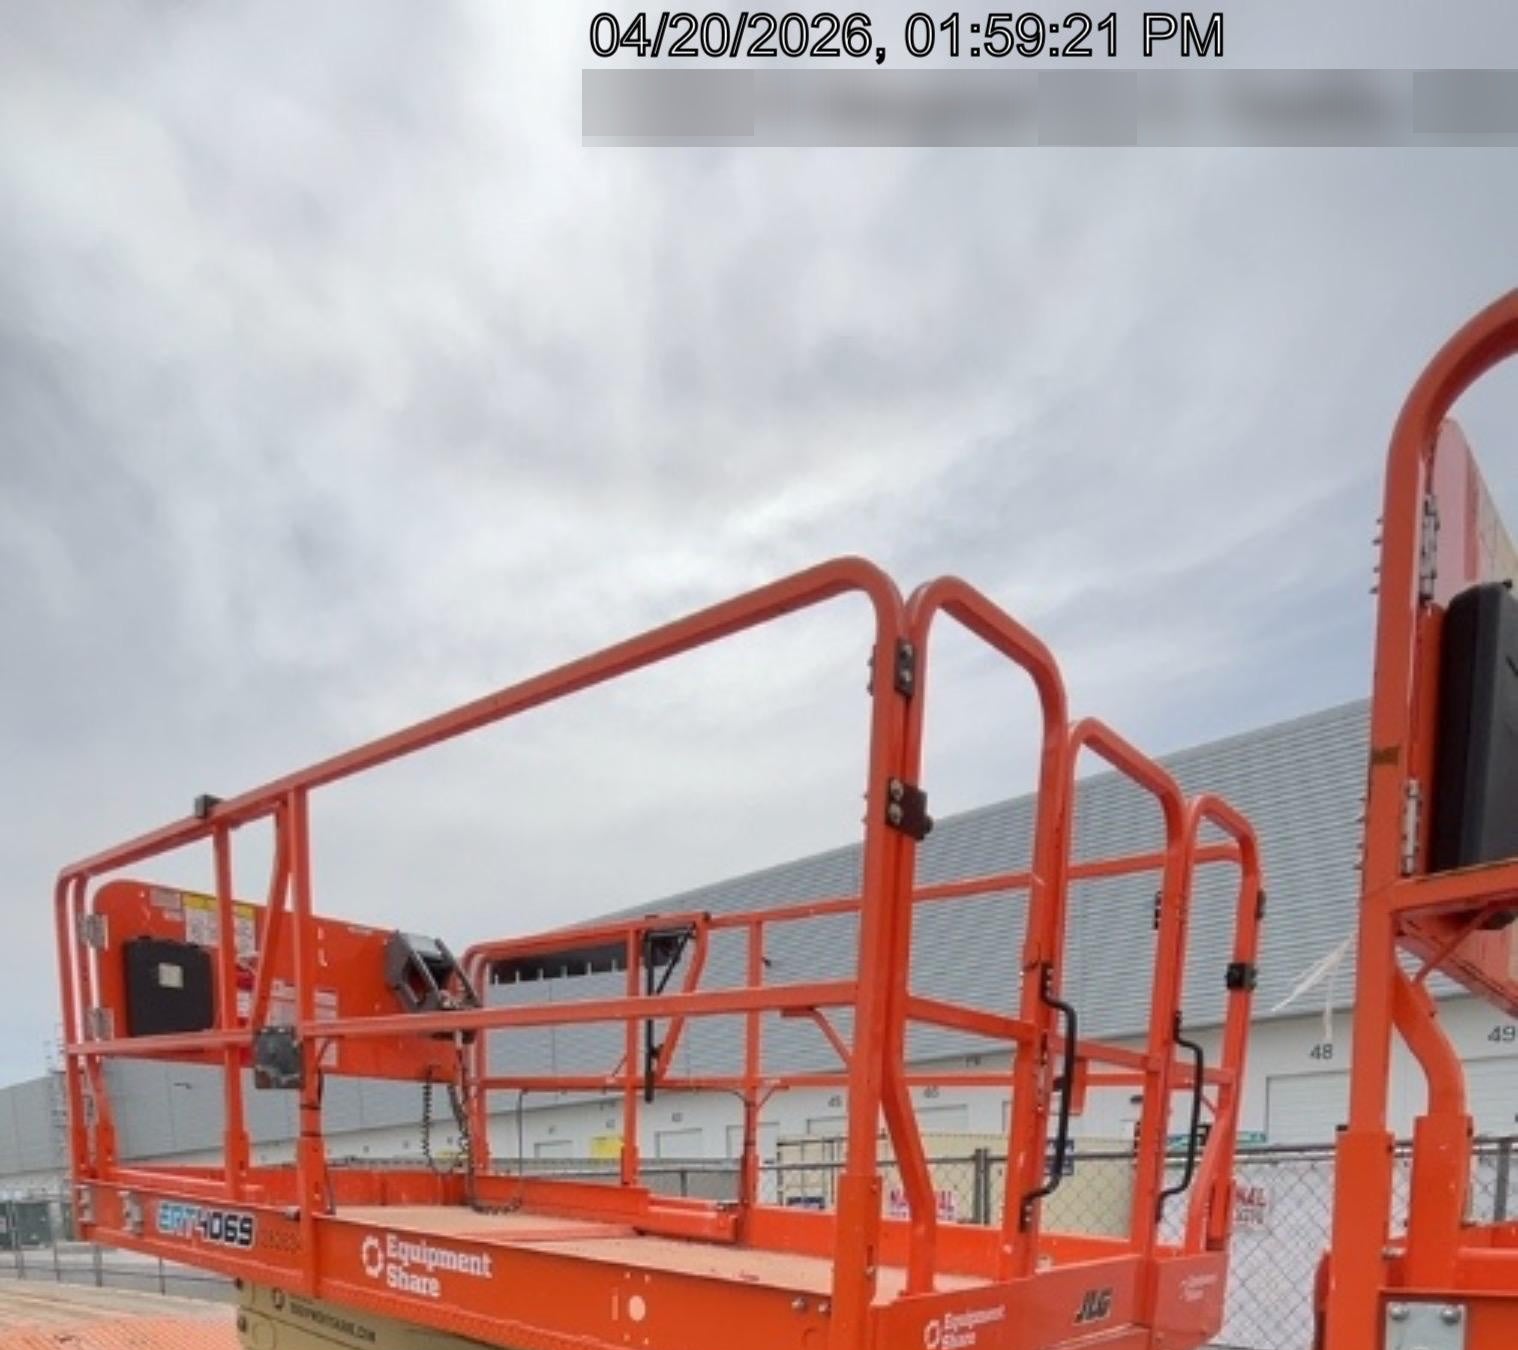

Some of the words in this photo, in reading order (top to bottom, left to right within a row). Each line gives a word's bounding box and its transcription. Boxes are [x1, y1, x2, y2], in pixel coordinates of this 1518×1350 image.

[1310, 1043, 1334, 1060] 48
[1488, 1025, 1515, 1042] 49
[386, 1233, 493, 1278] Equipment
[386, 1262, 441, 1298] Share
[1073, 1287, 1113, 1325] JLG
